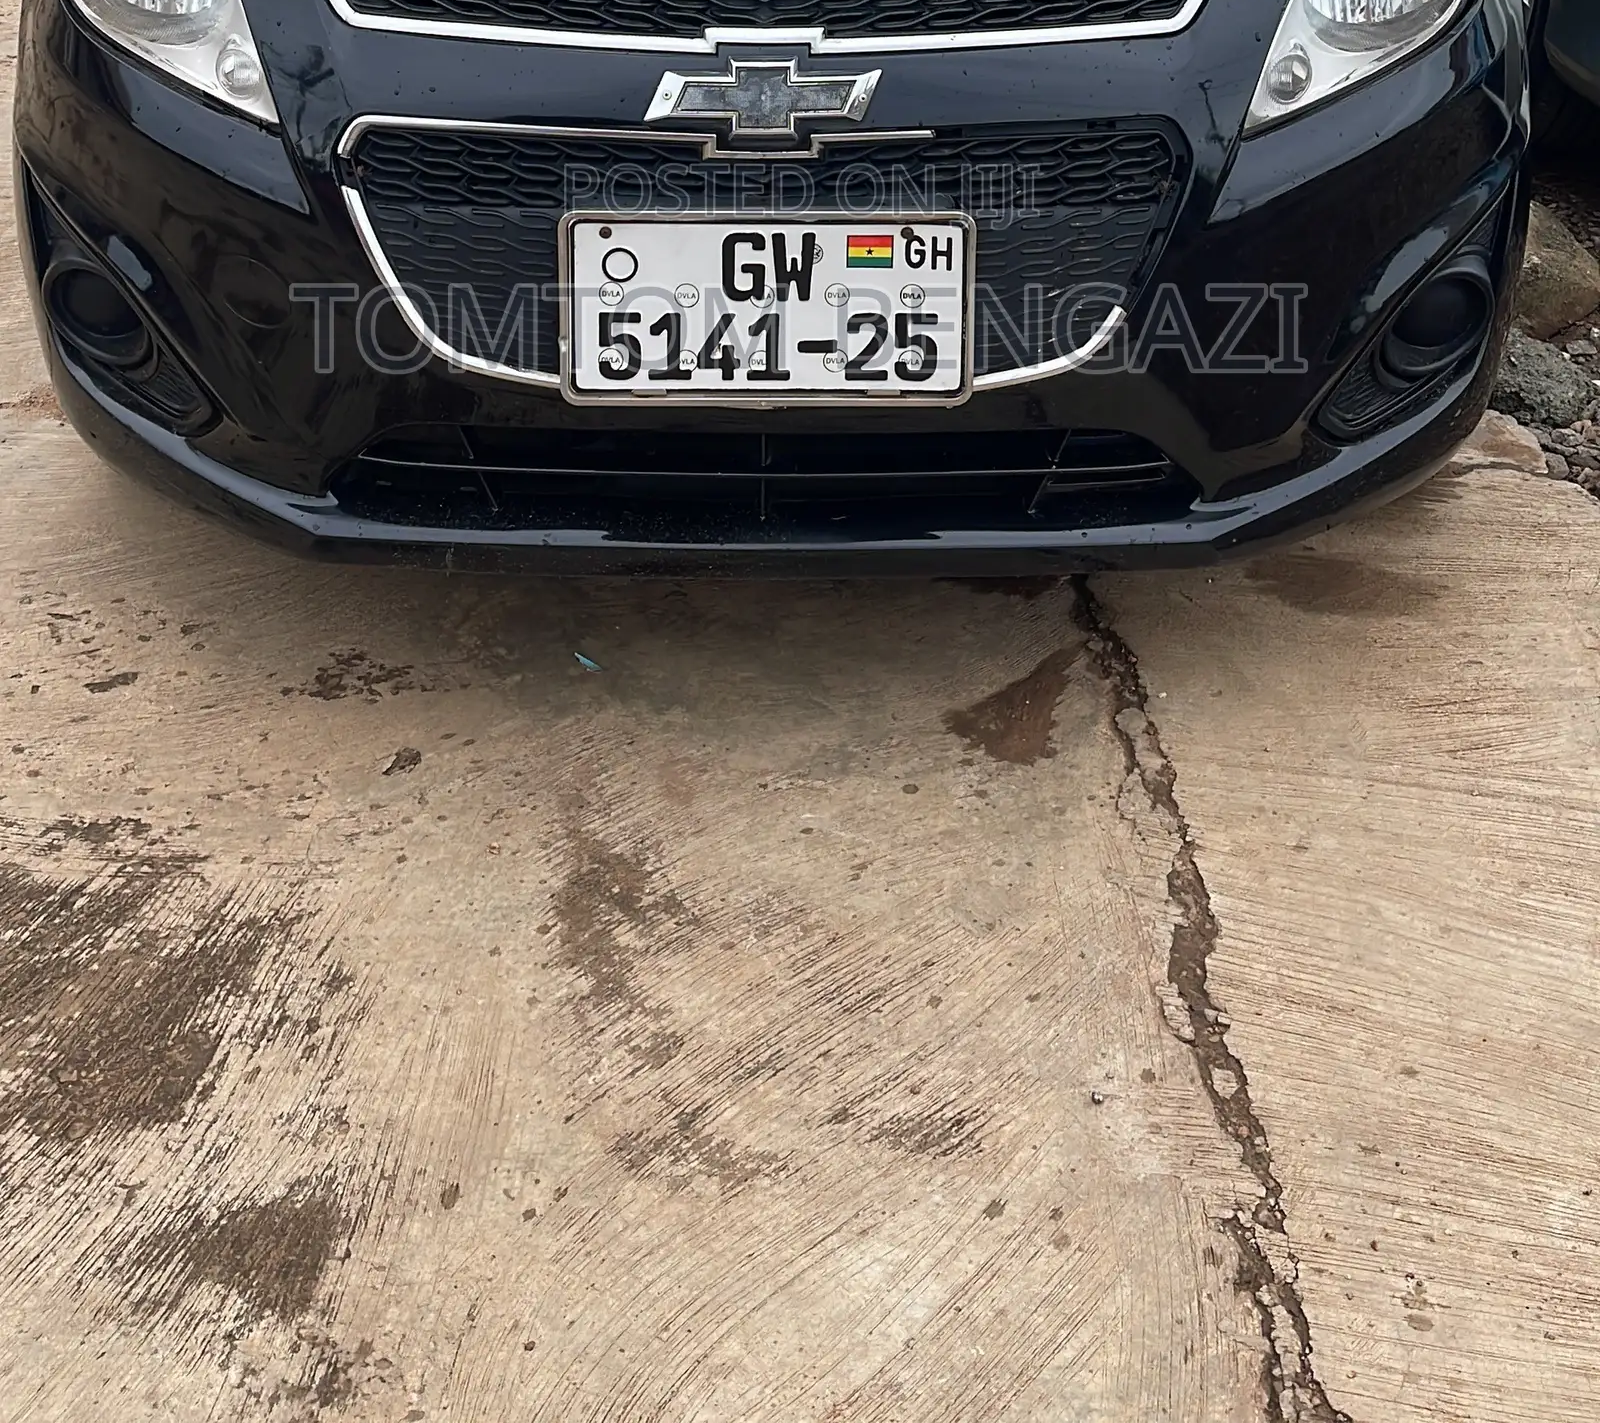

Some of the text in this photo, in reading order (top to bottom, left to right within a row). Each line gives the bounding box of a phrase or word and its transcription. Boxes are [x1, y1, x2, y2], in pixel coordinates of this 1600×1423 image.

[904, 234, 953, 271] GH
[722, 232, 816, 302] GW
[601, 289, 622, 297] DVLA
[677, 292, 697, 300] DVLA
[827, 291, 847, 299] DVLA
[903, 292, 922, 300] DVLA
[599, 313, 938, 381] 5141-25
[751, 358, 766, 366] DVL
[825, 357, 845, 365] DVLA
